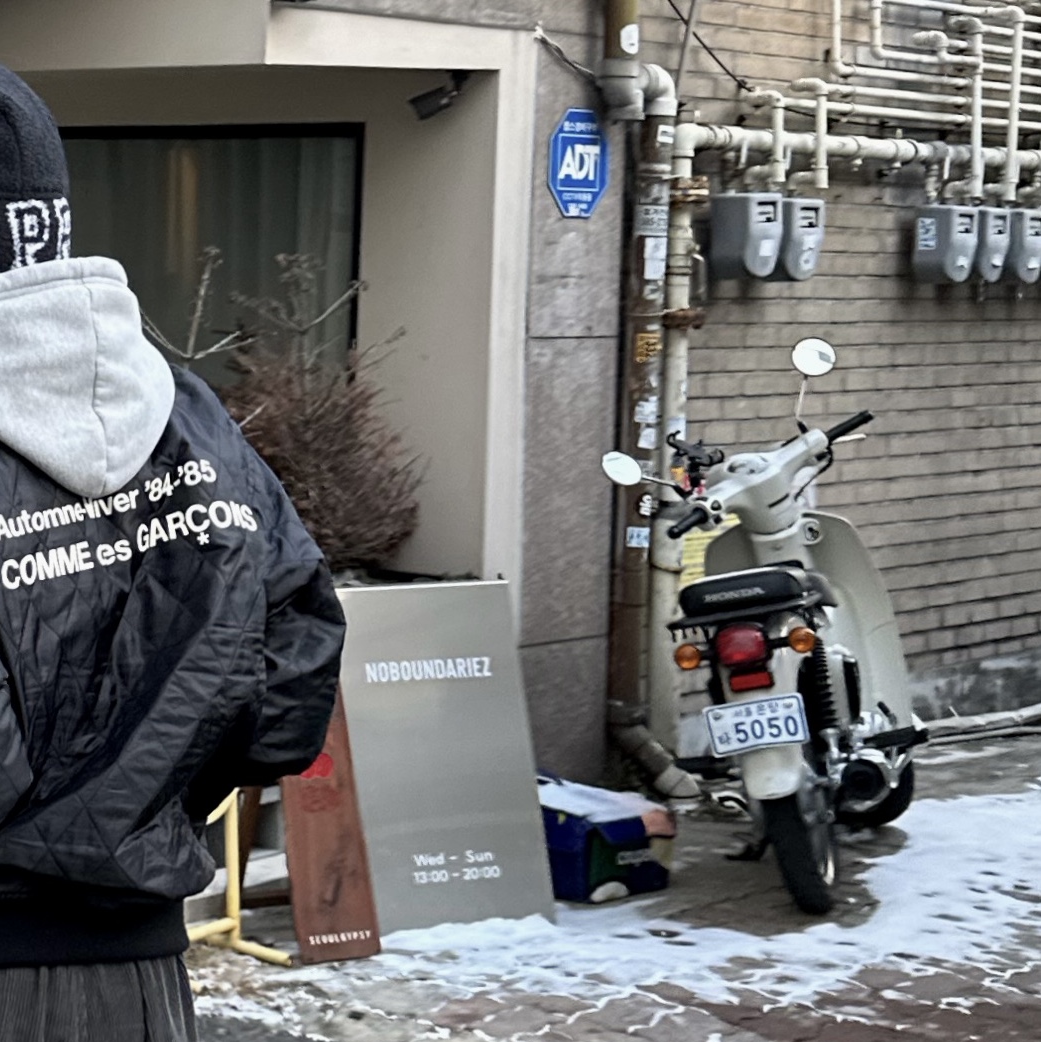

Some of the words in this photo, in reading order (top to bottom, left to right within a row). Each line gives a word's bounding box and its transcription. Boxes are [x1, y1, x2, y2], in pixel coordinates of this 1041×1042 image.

[558, 144, 601, 180] ADT
[1, 541, 95, 590] COMME
[703, 587, 766, 602] HONDA
[365, 656, 493, 683] NOBOUNDARIEZ
[734, 716, 799, 743] 5050
[413, 852, 445, 867] Wed
[465, 850, 493, 863] Sun
[462, 865, 501, 880] 20:00
